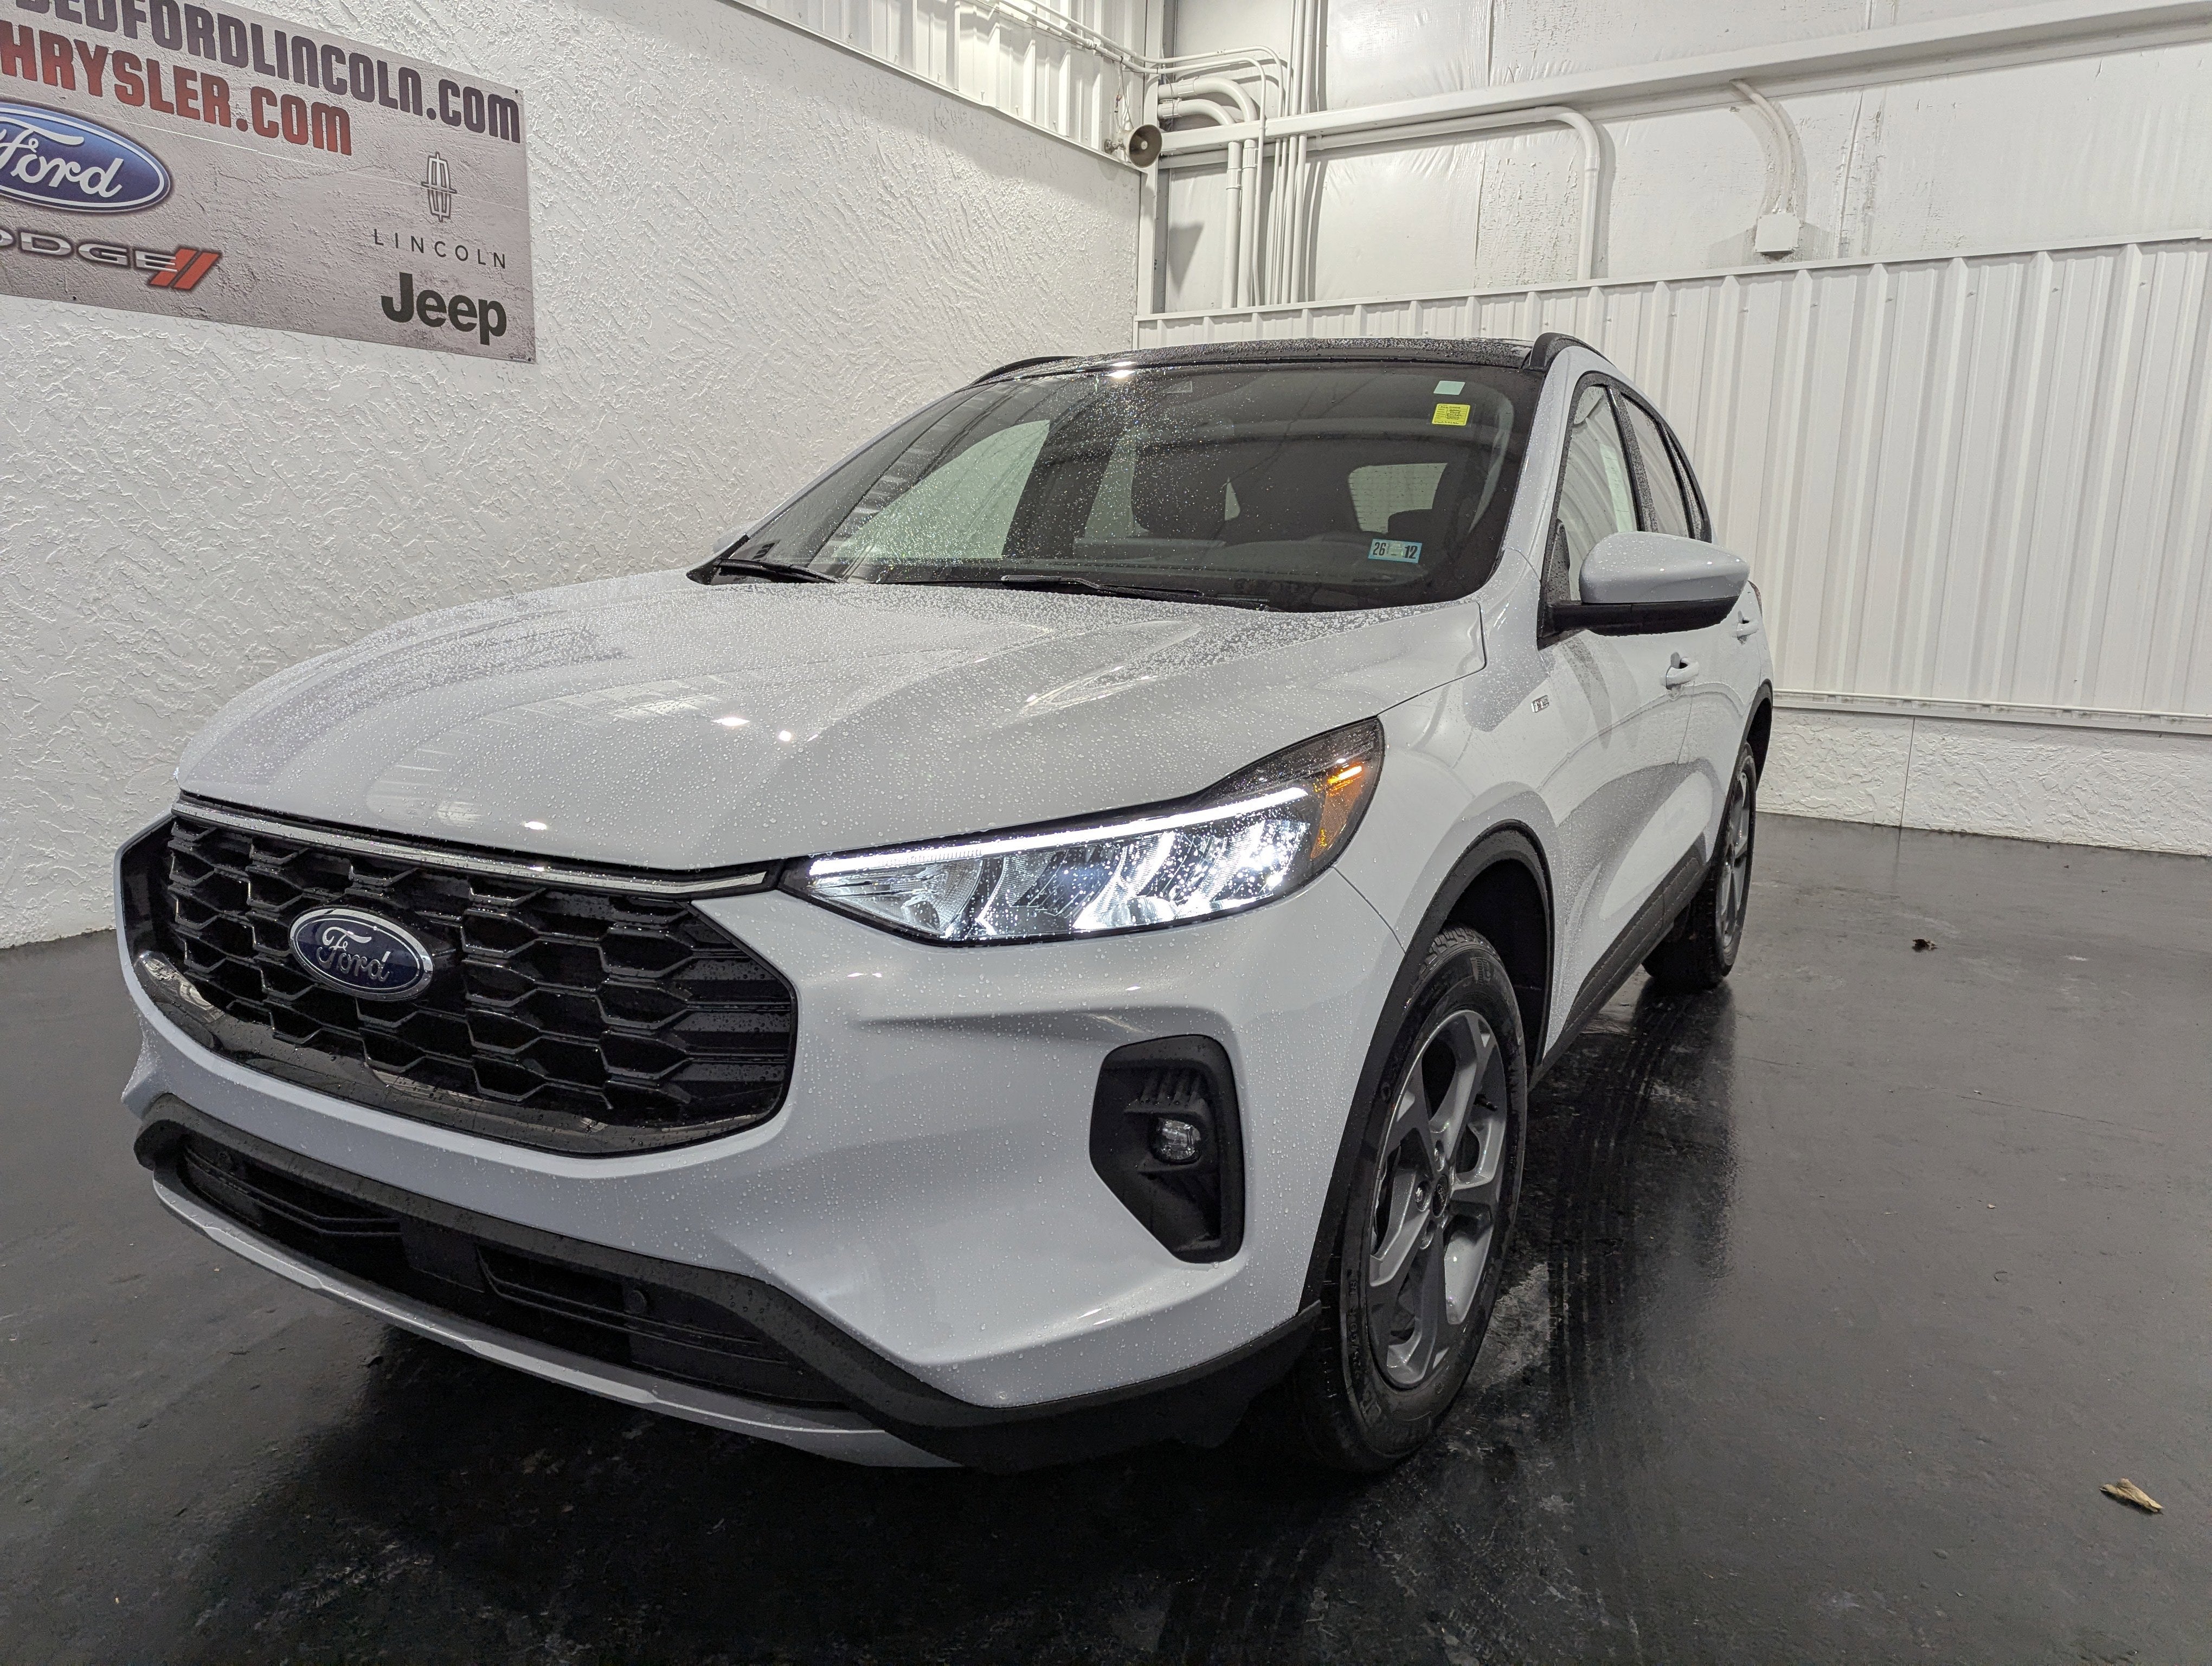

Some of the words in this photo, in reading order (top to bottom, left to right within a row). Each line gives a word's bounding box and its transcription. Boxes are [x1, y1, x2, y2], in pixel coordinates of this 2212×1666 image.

[0, 20, 352, 156] HRYSLER.COM
[16, 0, 520, 143] DFORDLINCOLN.COM
[0, 228, 178, 272] DGE
[374, 228, 506, 269] LINCOLN
[381, 272, 507, 345] Jeep
[1372, 542, 1386, 556] 26
[1404, 545, 1418, 559] 12
[316, 926, 391, 982] Ford
